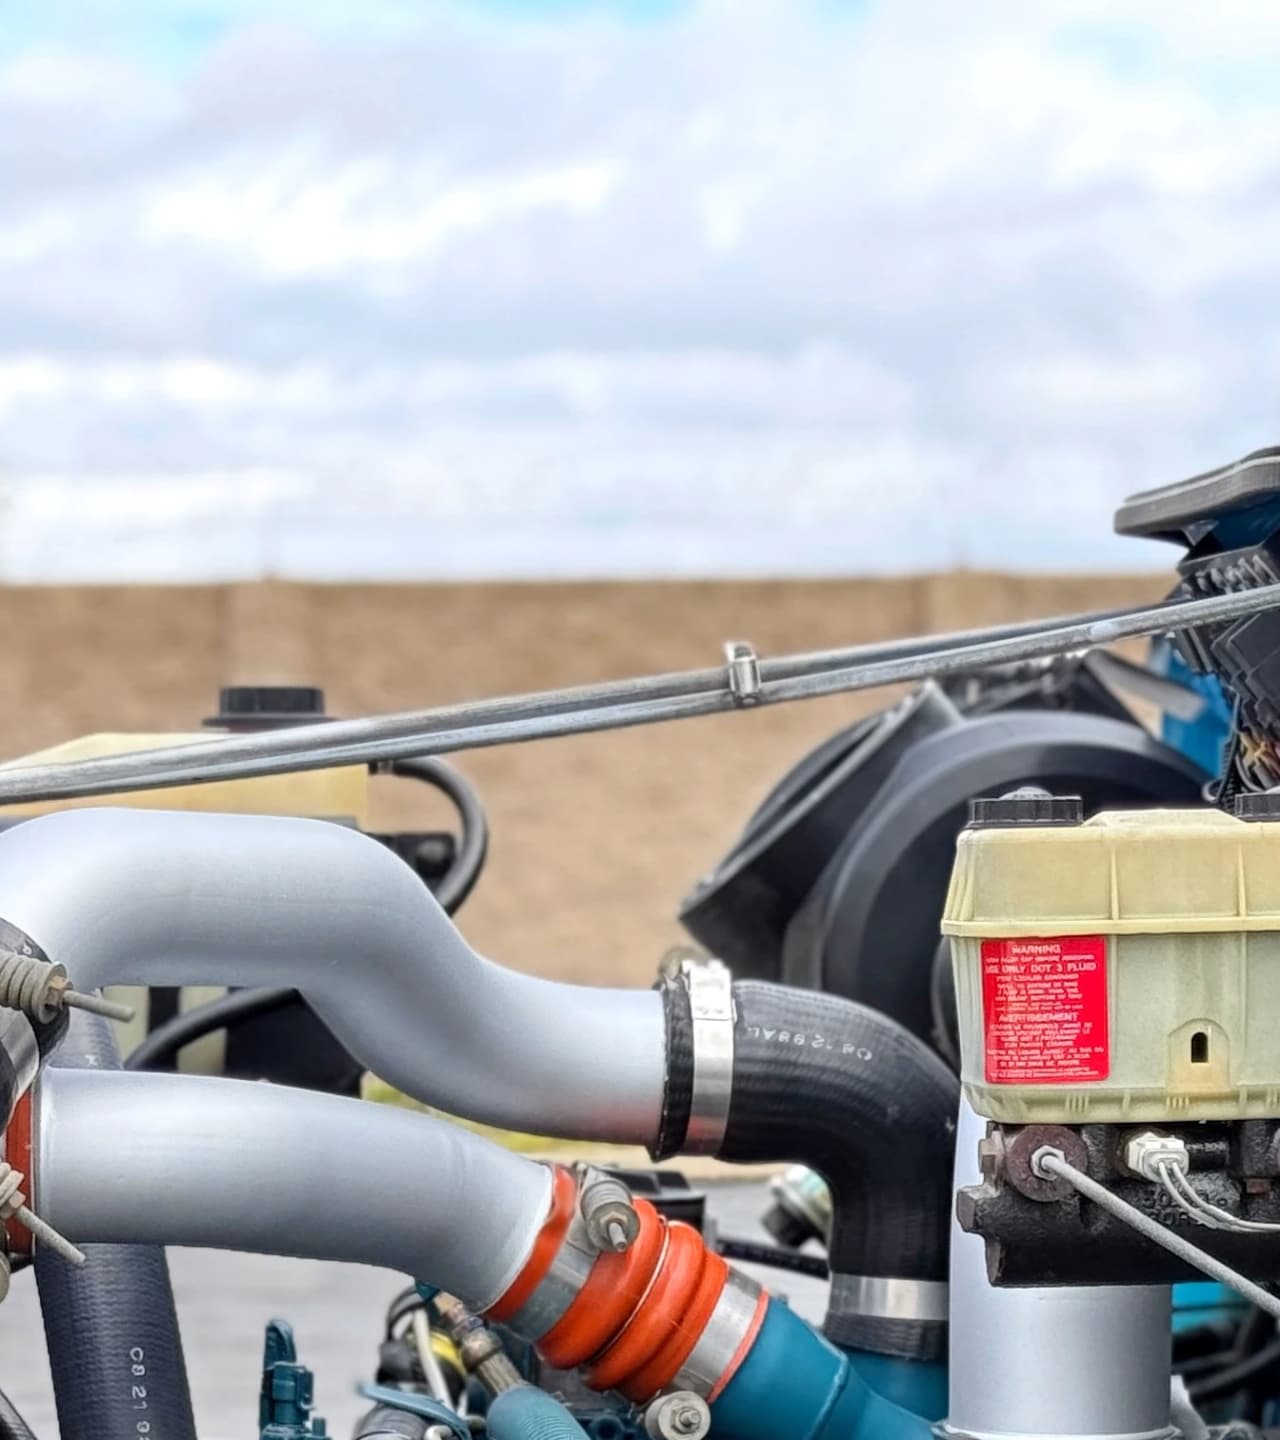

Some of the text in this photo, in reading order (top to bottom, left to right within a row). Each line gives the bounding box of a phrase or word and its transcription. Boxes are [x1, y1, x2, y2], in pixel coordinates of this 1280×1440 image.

[1011, 944, 1061, 954] WARNING
[1030, 963, 1052, 972] DOT
[1055, 963, 1062, 972] 3
[1067, 961, 1097, 971] FLUID
